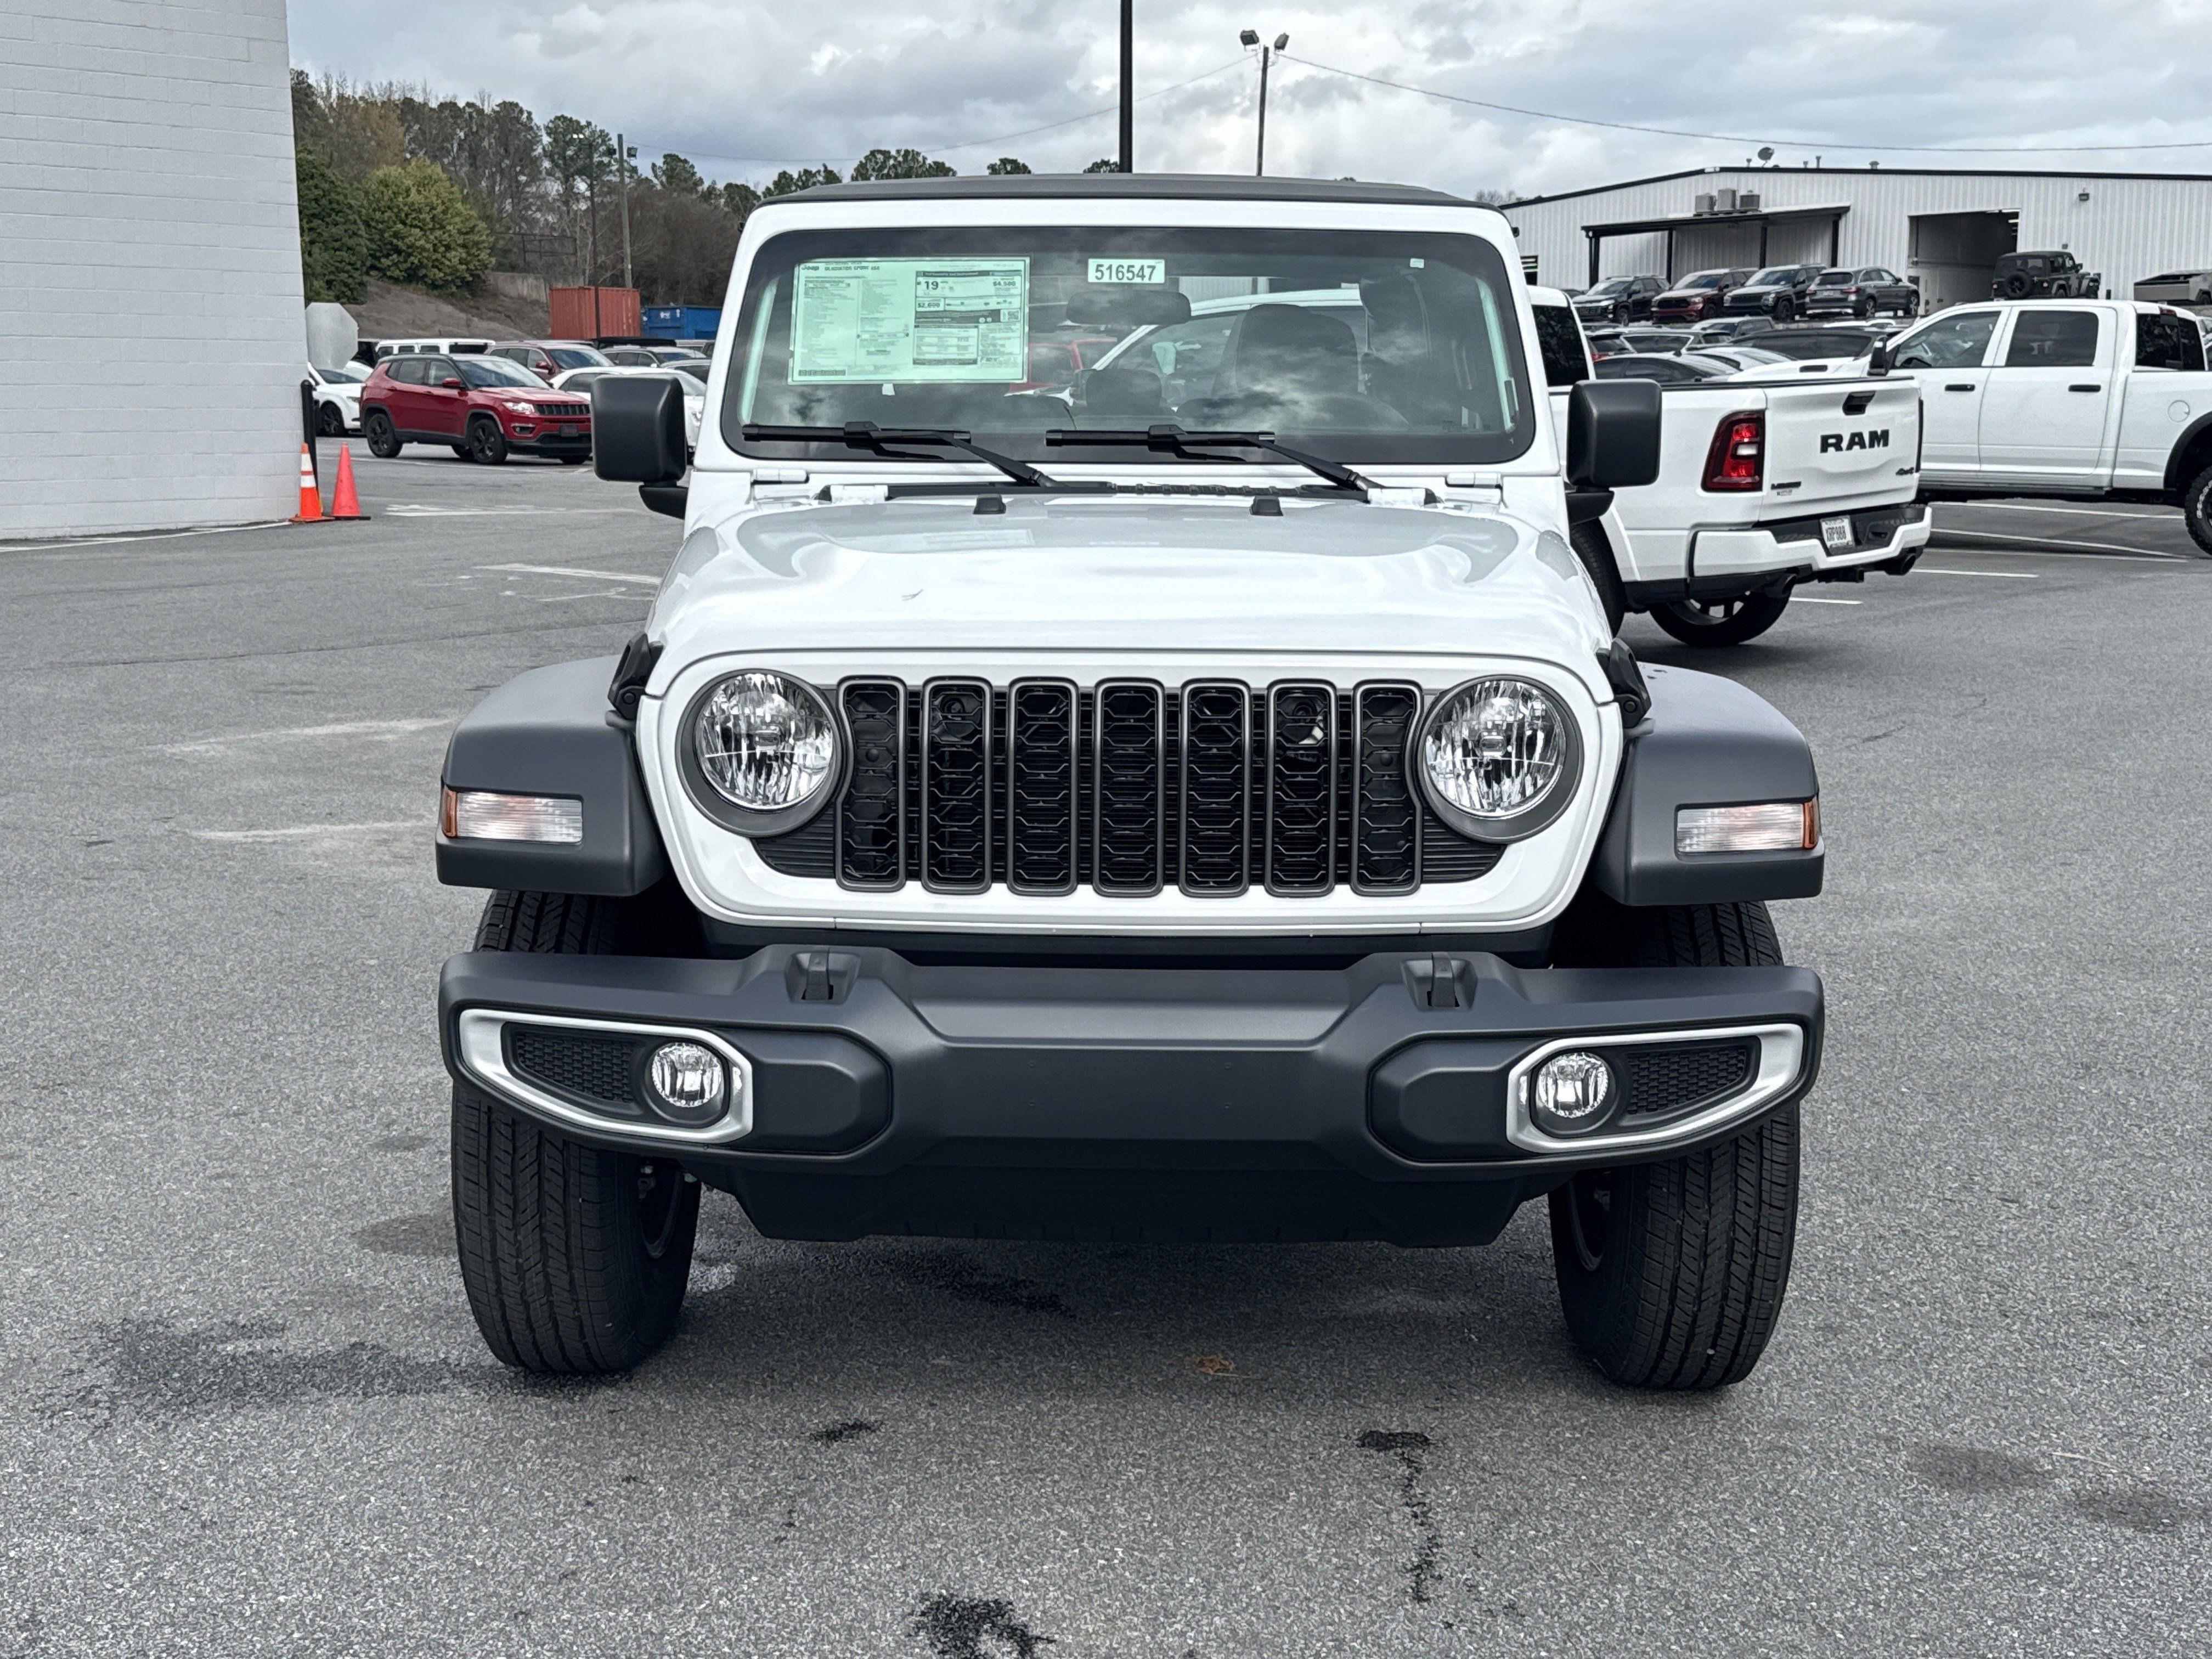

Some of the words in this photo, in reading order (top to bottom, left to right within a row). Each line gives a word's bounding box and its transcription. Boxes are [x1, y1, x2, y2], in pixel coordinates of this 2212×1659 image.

[1094, 264, 1156, 281] 516547
[924, 281, 939, 290] 19
[1820, 429, 1889, 454] RAM
